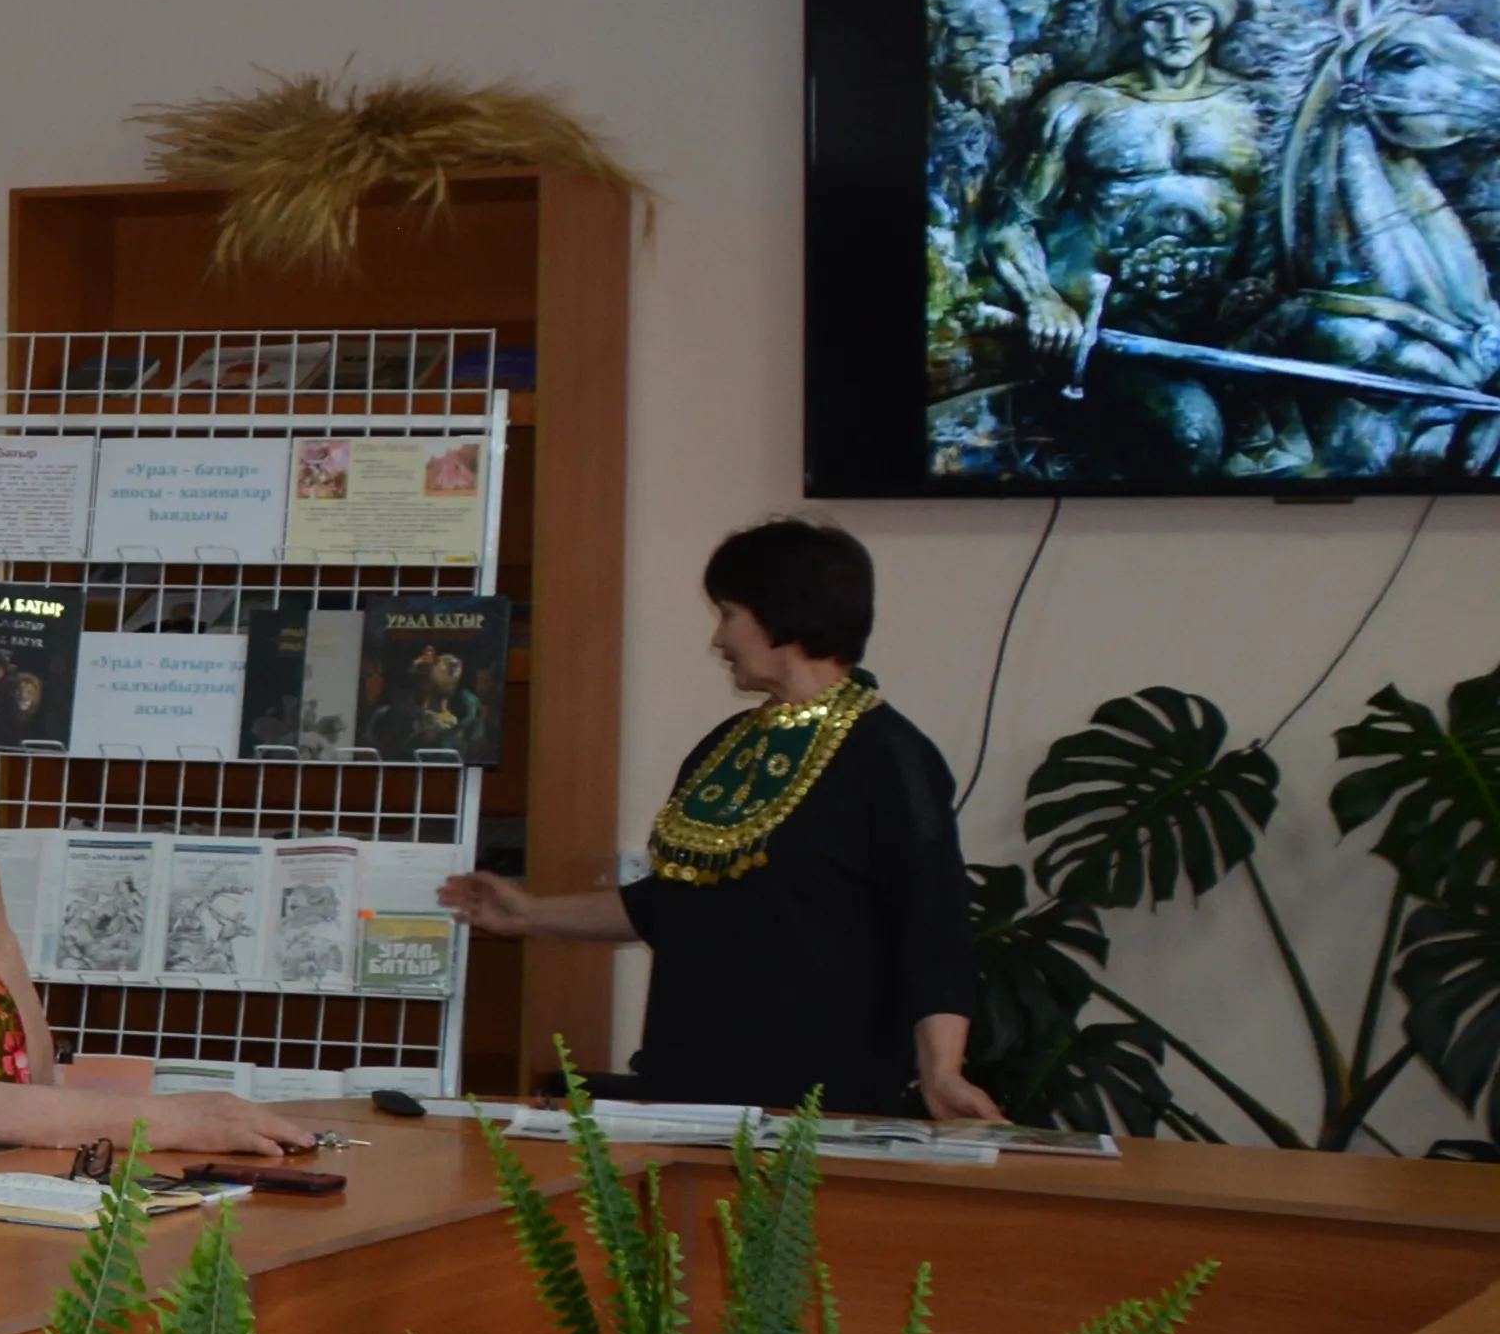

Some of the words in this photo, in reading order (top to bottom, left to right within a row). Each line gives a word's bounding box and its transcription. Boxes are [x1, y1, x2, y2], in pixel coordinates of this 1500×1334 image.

[125, 463, 178, 479] «Урал
[195, 462, 258, 479] батыр»
[14, 598, 65, 618] БАТЫР
[386, 613, 429, 629] УРАЛ
[433, 613, 485, 629] БАТЫР
[368, 958, 440, 975] БАТЫР
